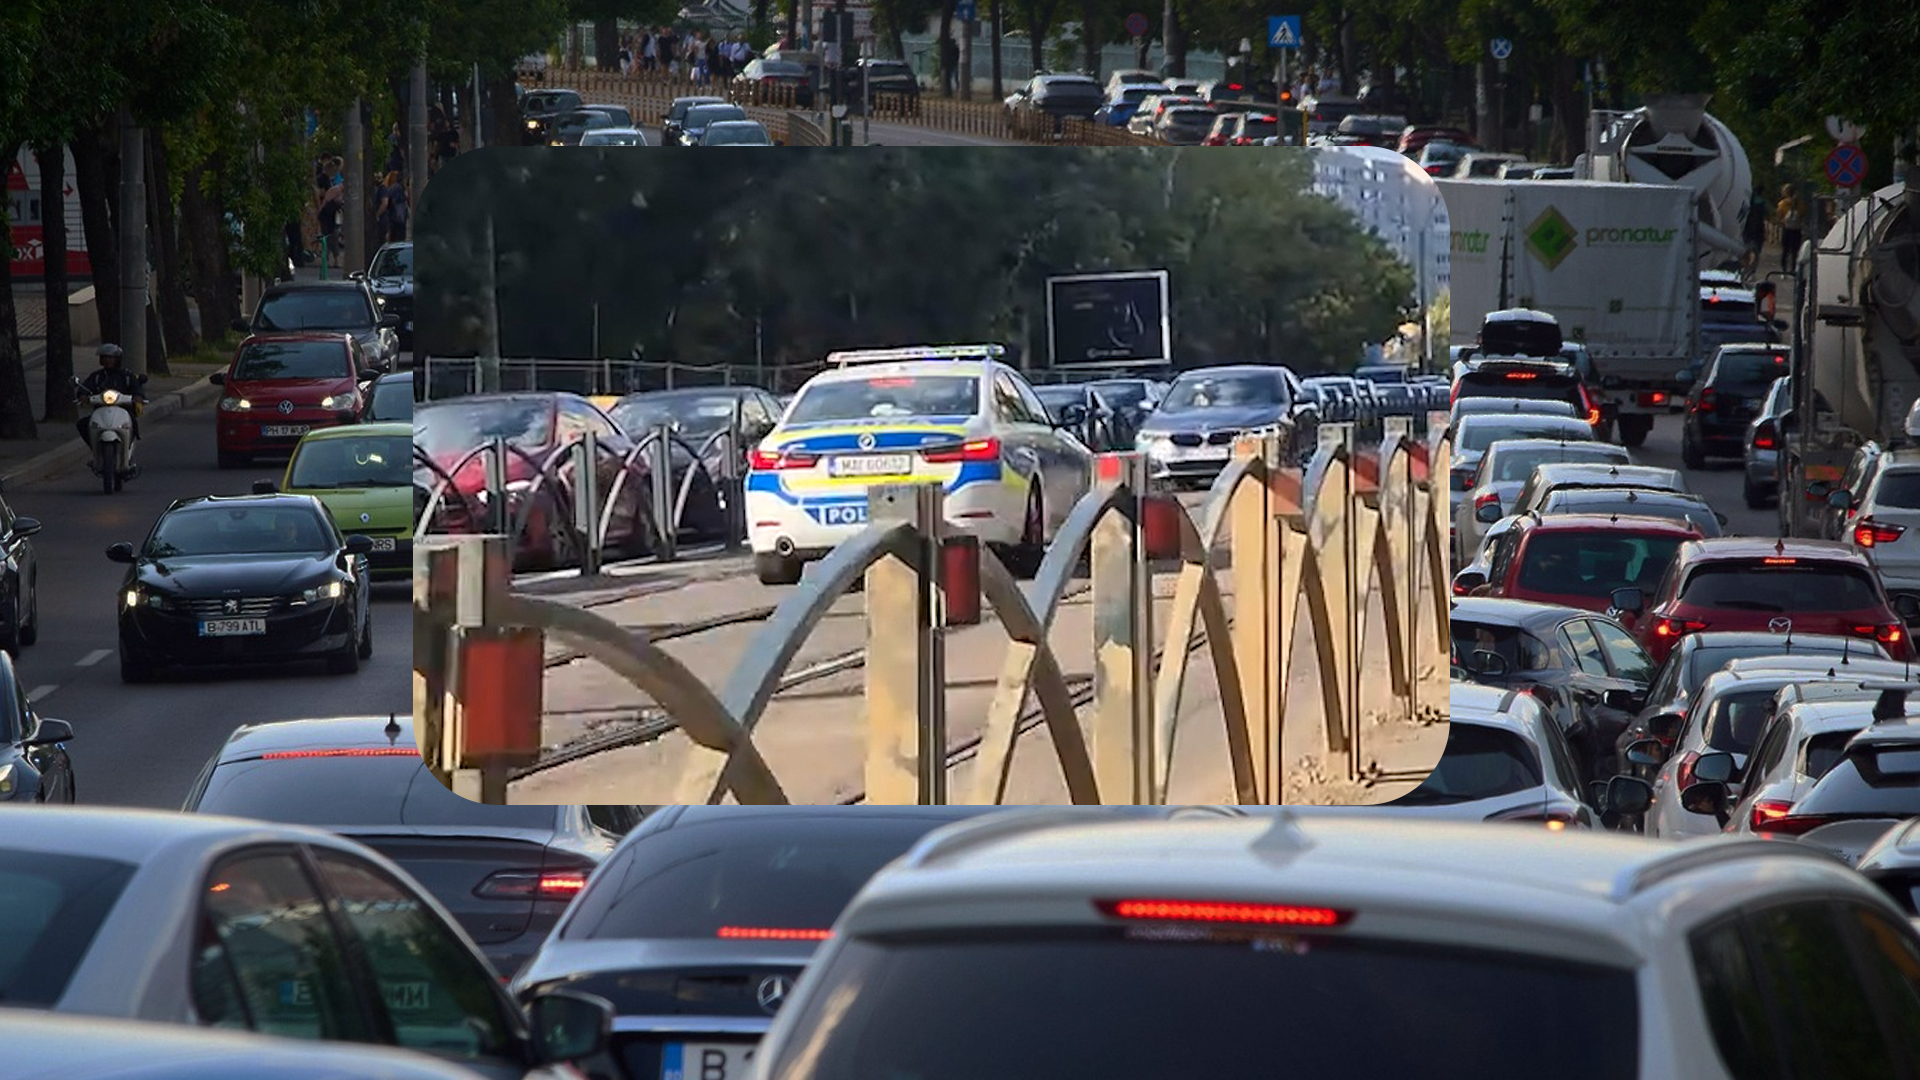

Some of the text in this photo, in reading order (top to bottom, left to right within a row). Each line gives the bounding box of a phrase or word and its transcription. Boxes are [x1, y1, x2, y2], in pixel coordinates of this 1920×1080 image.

[1586, 226, 1678, 247] pronatur
[267, 425, 279, 436] PH
[281, 425, 289, 436] 17
[828, 507, 867, 523] POL
[207, 620, 262, 633] B 799 ATL
[701, 1049, 727, 1080] B
